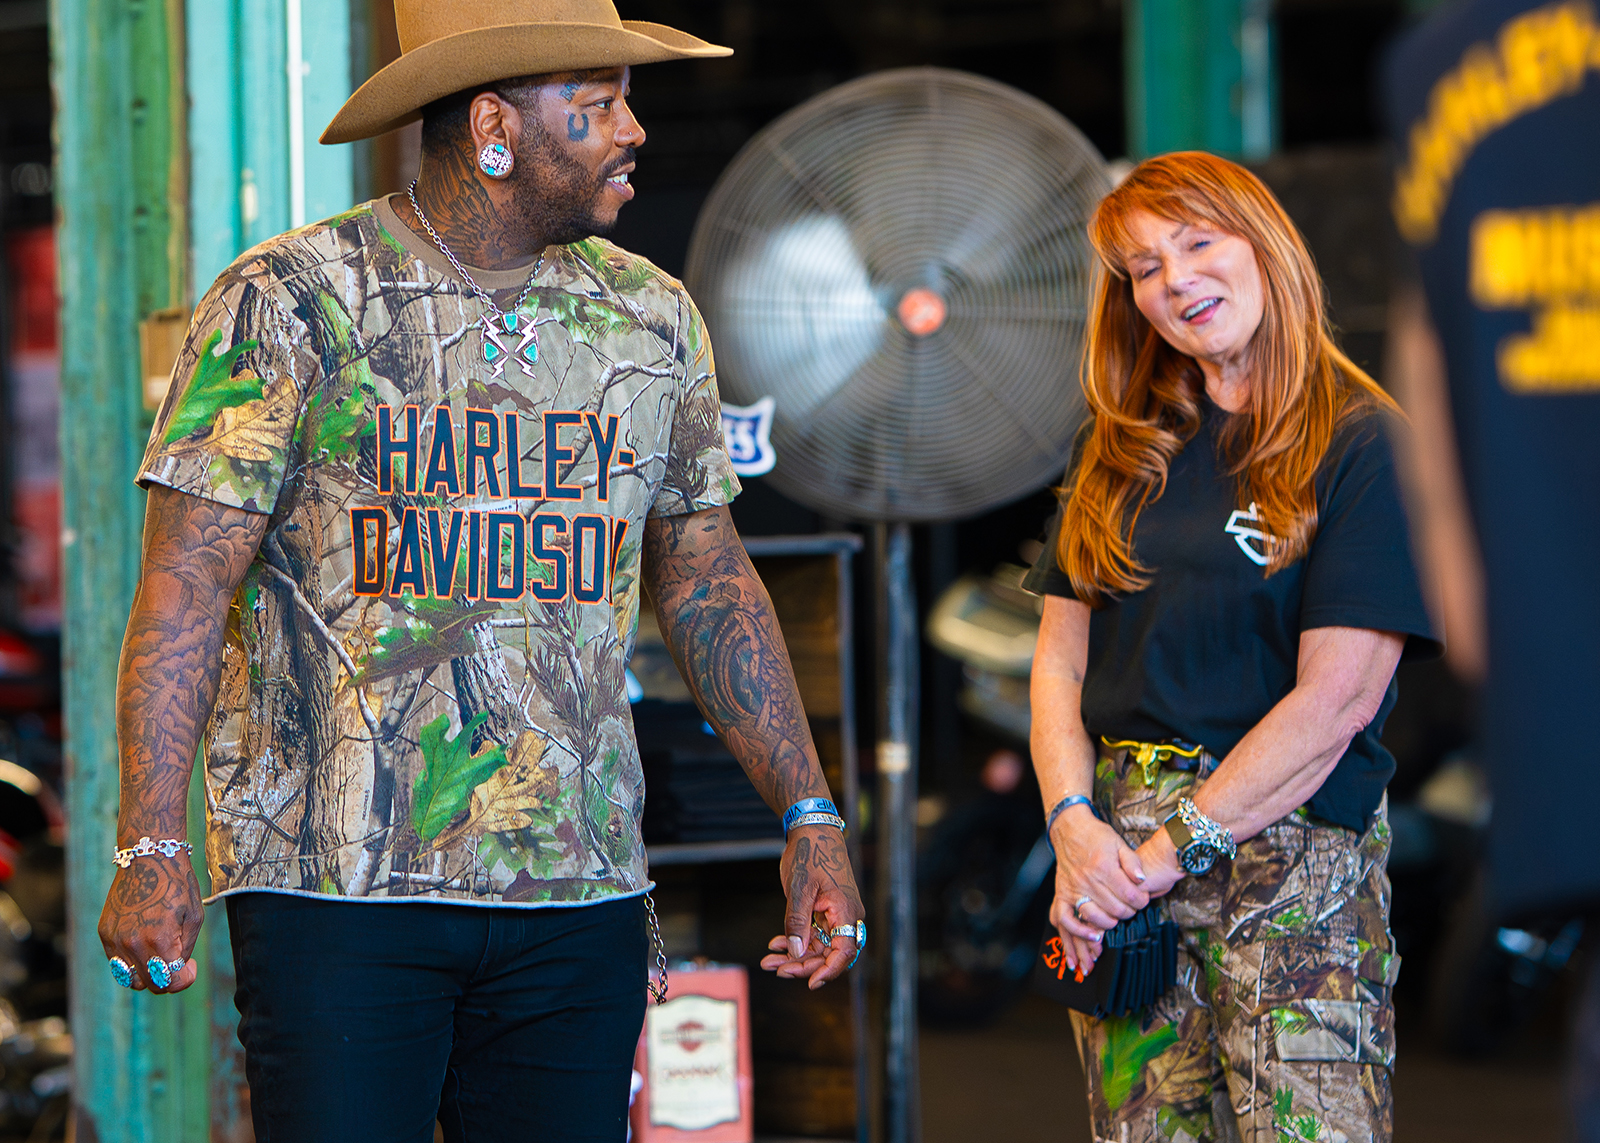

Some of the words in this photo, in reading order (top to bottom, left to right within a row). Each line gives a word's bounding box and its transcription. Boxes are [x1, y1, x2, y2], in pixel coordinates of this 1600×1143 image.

[376, 404, 635, 502] HARLEY-
[785, 805, 802, 823] VIP
[816, 799, 836, 813] VIP
